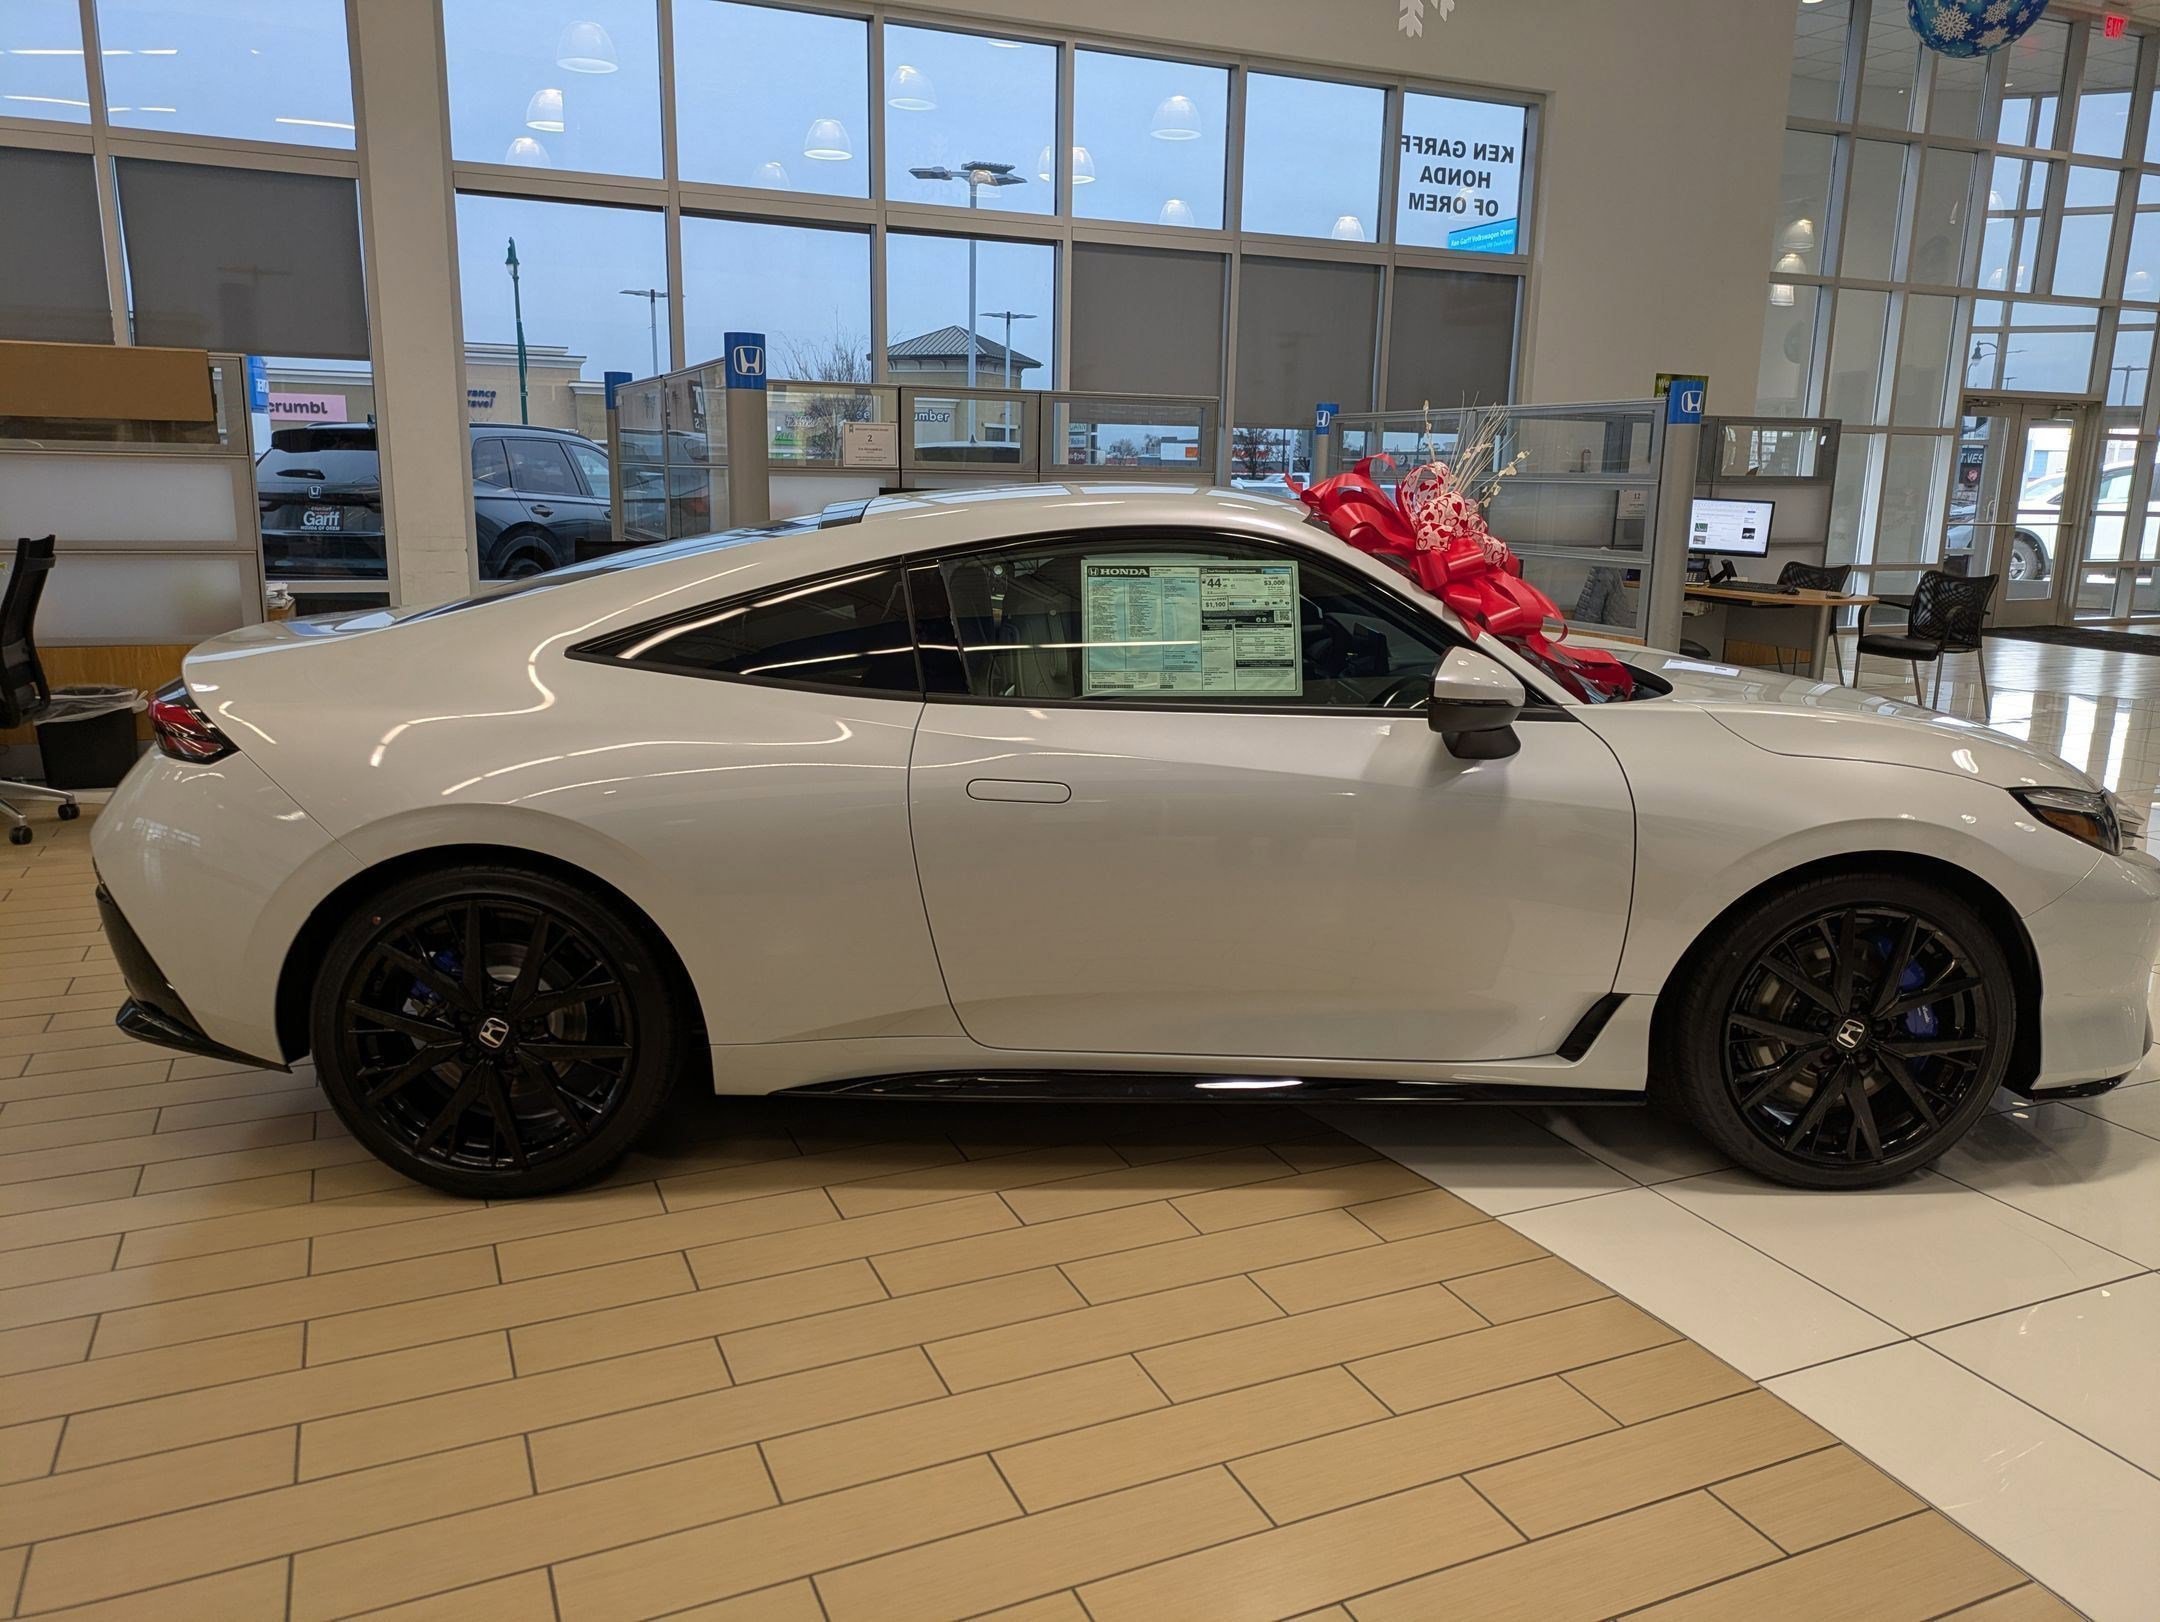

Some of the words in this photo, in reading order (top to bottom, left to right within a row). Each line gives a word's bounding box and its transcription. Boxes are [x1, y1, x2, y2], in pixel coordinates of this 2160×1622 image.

[2105, 16, 2124, 38] EXIT
[268, 401, 329, 415] crumbl
[867, 434, 873, 442] 2
[303, 510, 340, 526] Garff
[1100, 568, 1149, 576] HONDA
[1207, 578, 1222, 588] 44
